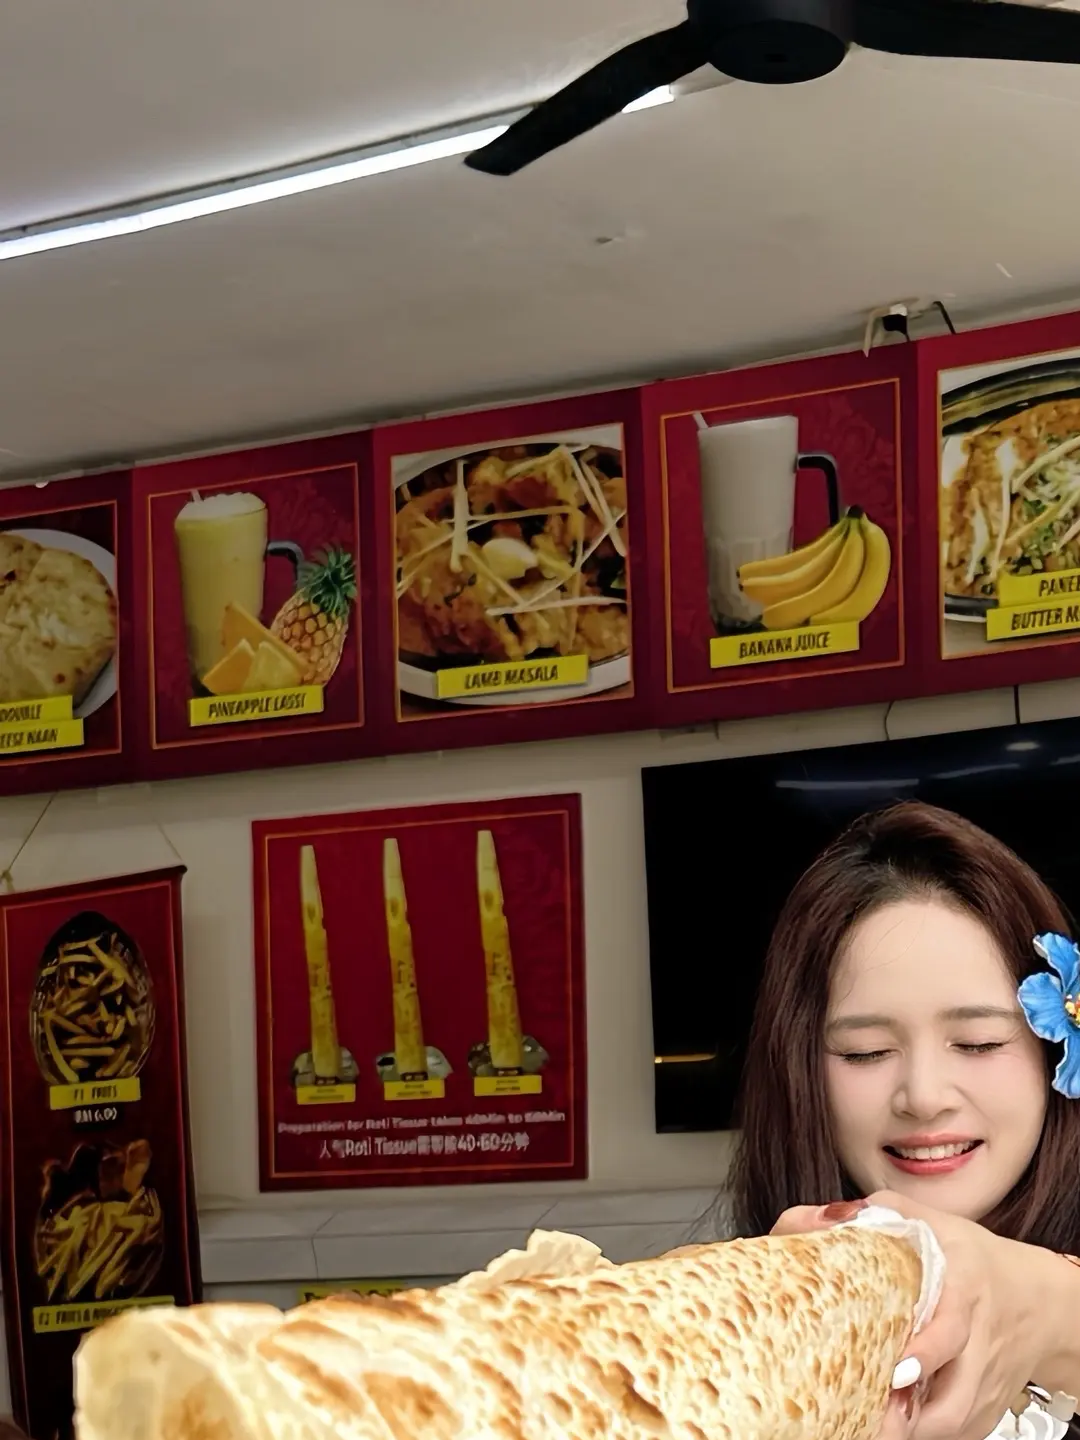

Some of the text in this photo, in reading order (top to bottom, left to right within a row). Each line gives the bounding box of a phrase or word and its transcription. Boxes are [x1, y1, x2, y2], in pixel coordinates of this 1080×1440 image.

[1011, 608, 1065, 631] BUTTER
[739, 631, 830, 659] BANANA JUICE
[464, 665, 559, 690] LAMB MASALA
[208, 693, 307, 718] PINEAPPLE LASSI
